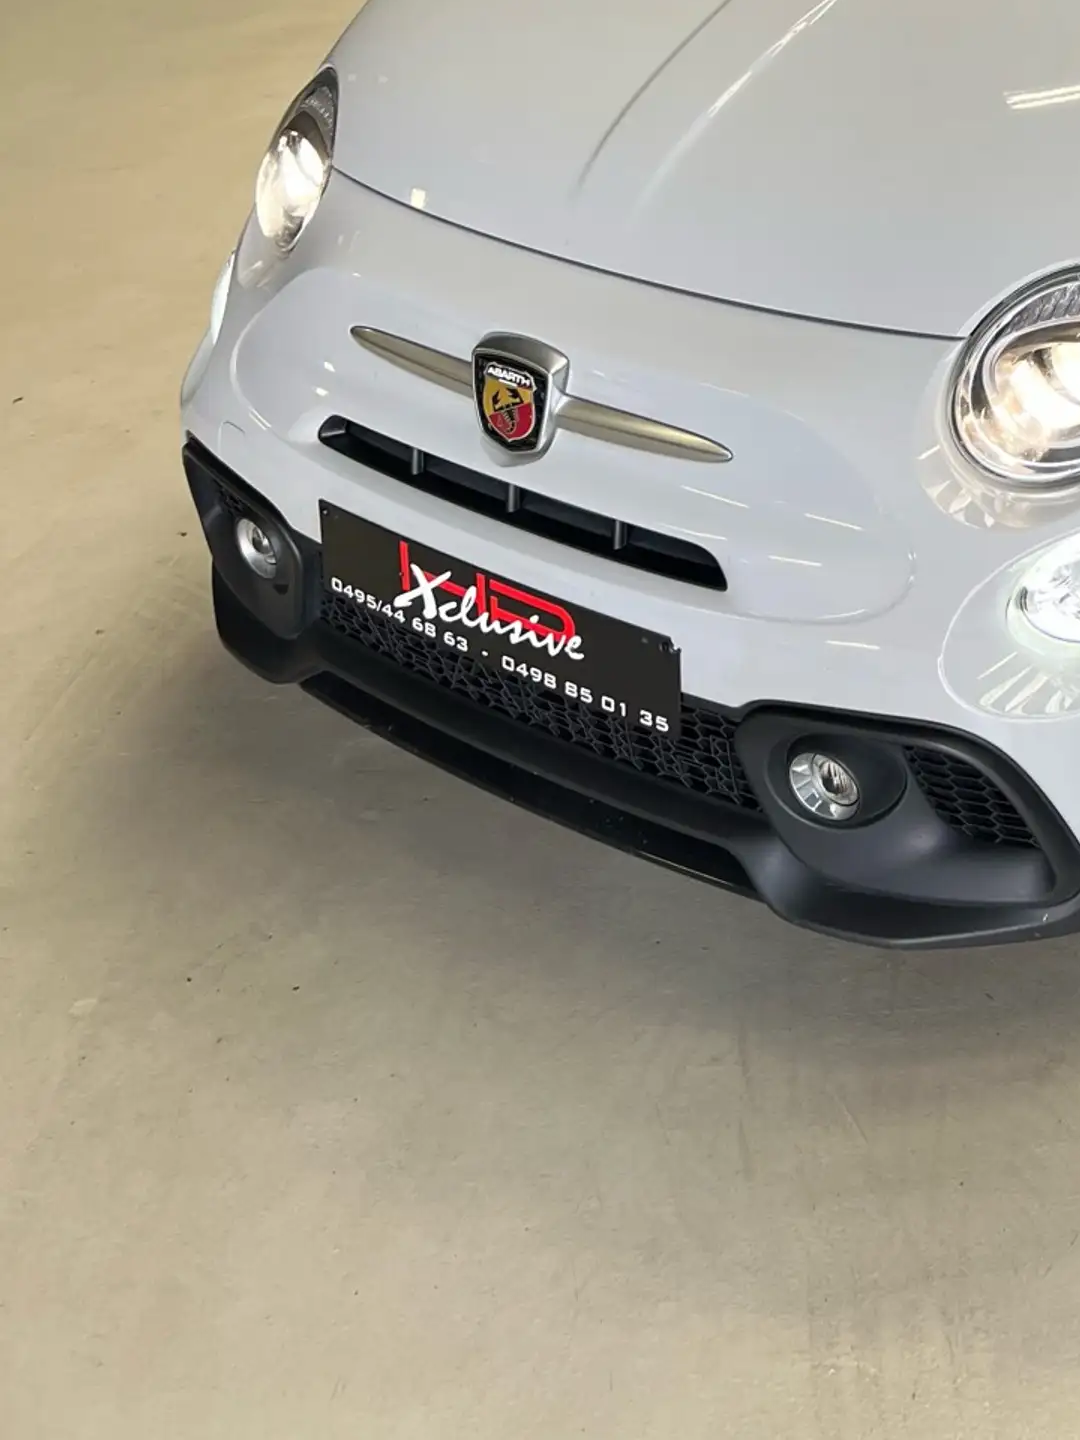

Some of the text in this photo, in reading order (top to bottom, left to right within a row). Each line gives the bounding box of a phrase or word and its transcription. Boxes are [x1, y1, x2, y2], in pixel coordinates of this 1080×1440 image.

[487, 366, 531, 387] ABARTH
[331, 576, 406, 623] 0495/44
[412, 617, 436, 638] 68
[443, 631, 468, 652] 63
[502, 655, 557, 689] 0498
[565, 681, 593, 704] 85
[601, 696, 627, 717] 01
[639, 709, 669, 732] 35
[394, 563, 585, 660] Xclusive
